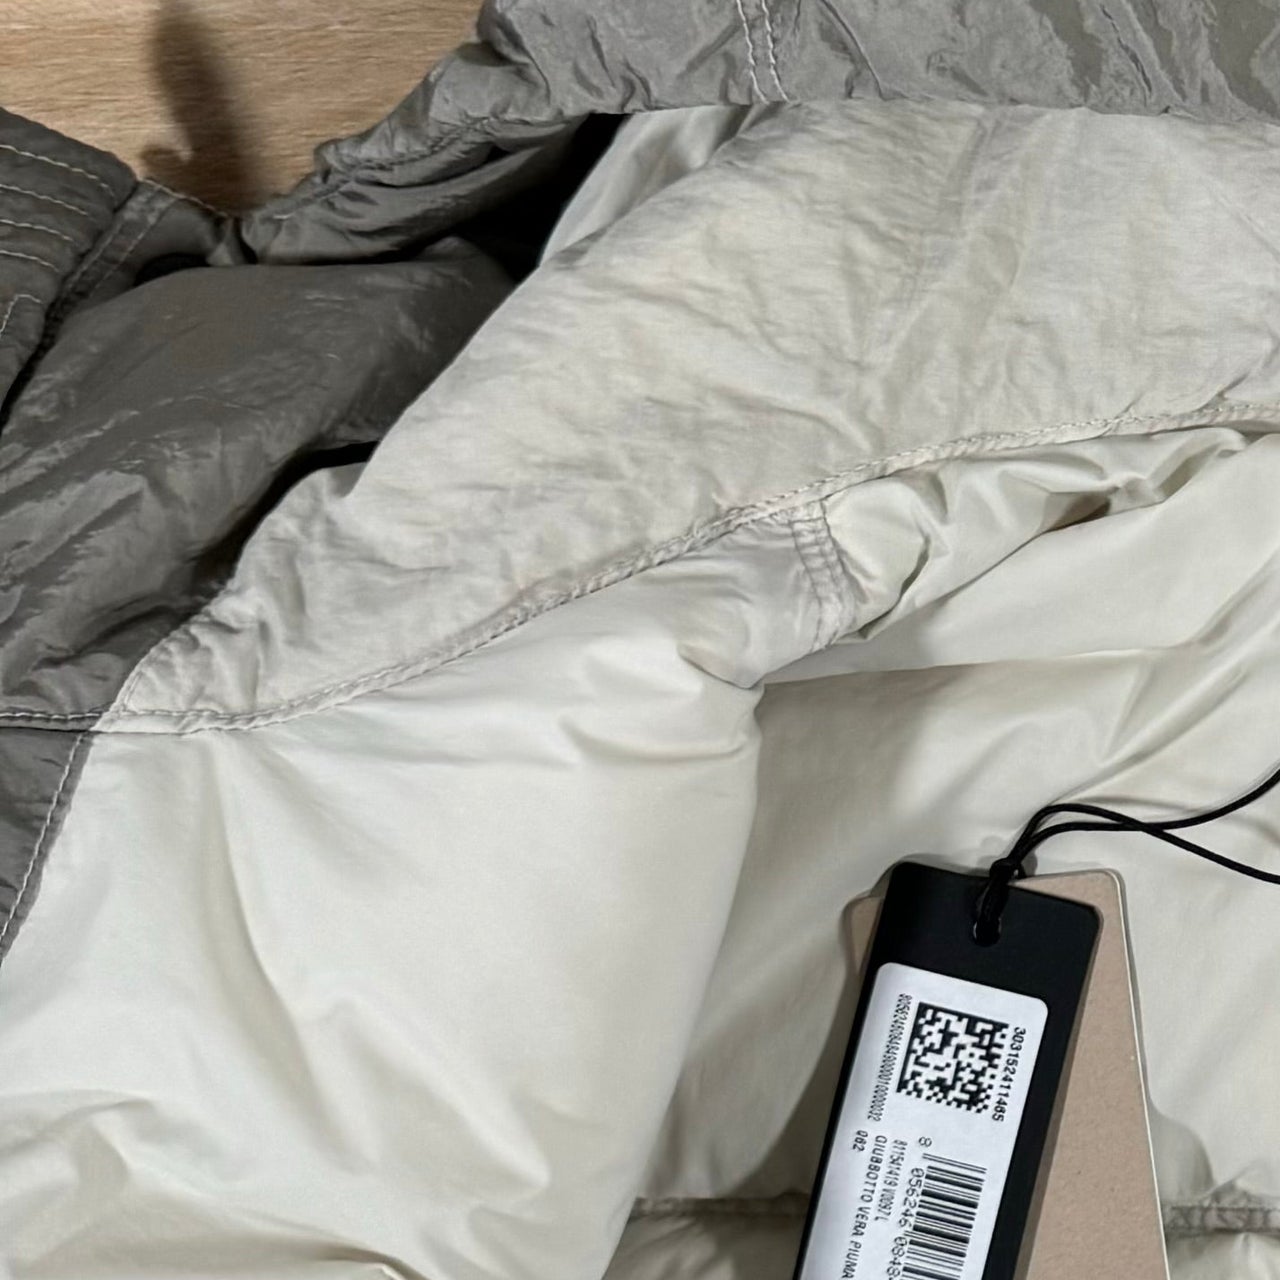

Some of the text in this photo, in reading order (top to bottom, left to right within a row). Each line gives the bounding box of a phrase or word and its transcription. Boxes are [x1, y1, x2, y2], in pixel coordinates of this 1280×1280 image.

[992, 1027, 1026, 1122] 303152411465
[918, 1136, 932, 1147] 8
[861, 1135, 888, 1203] GIUBBOTTO
[852, 1206, 871, 1237] VERA
[898, 1167, 925, 1229] 056246
[841, 1240, 862, 1279] PIUMA
